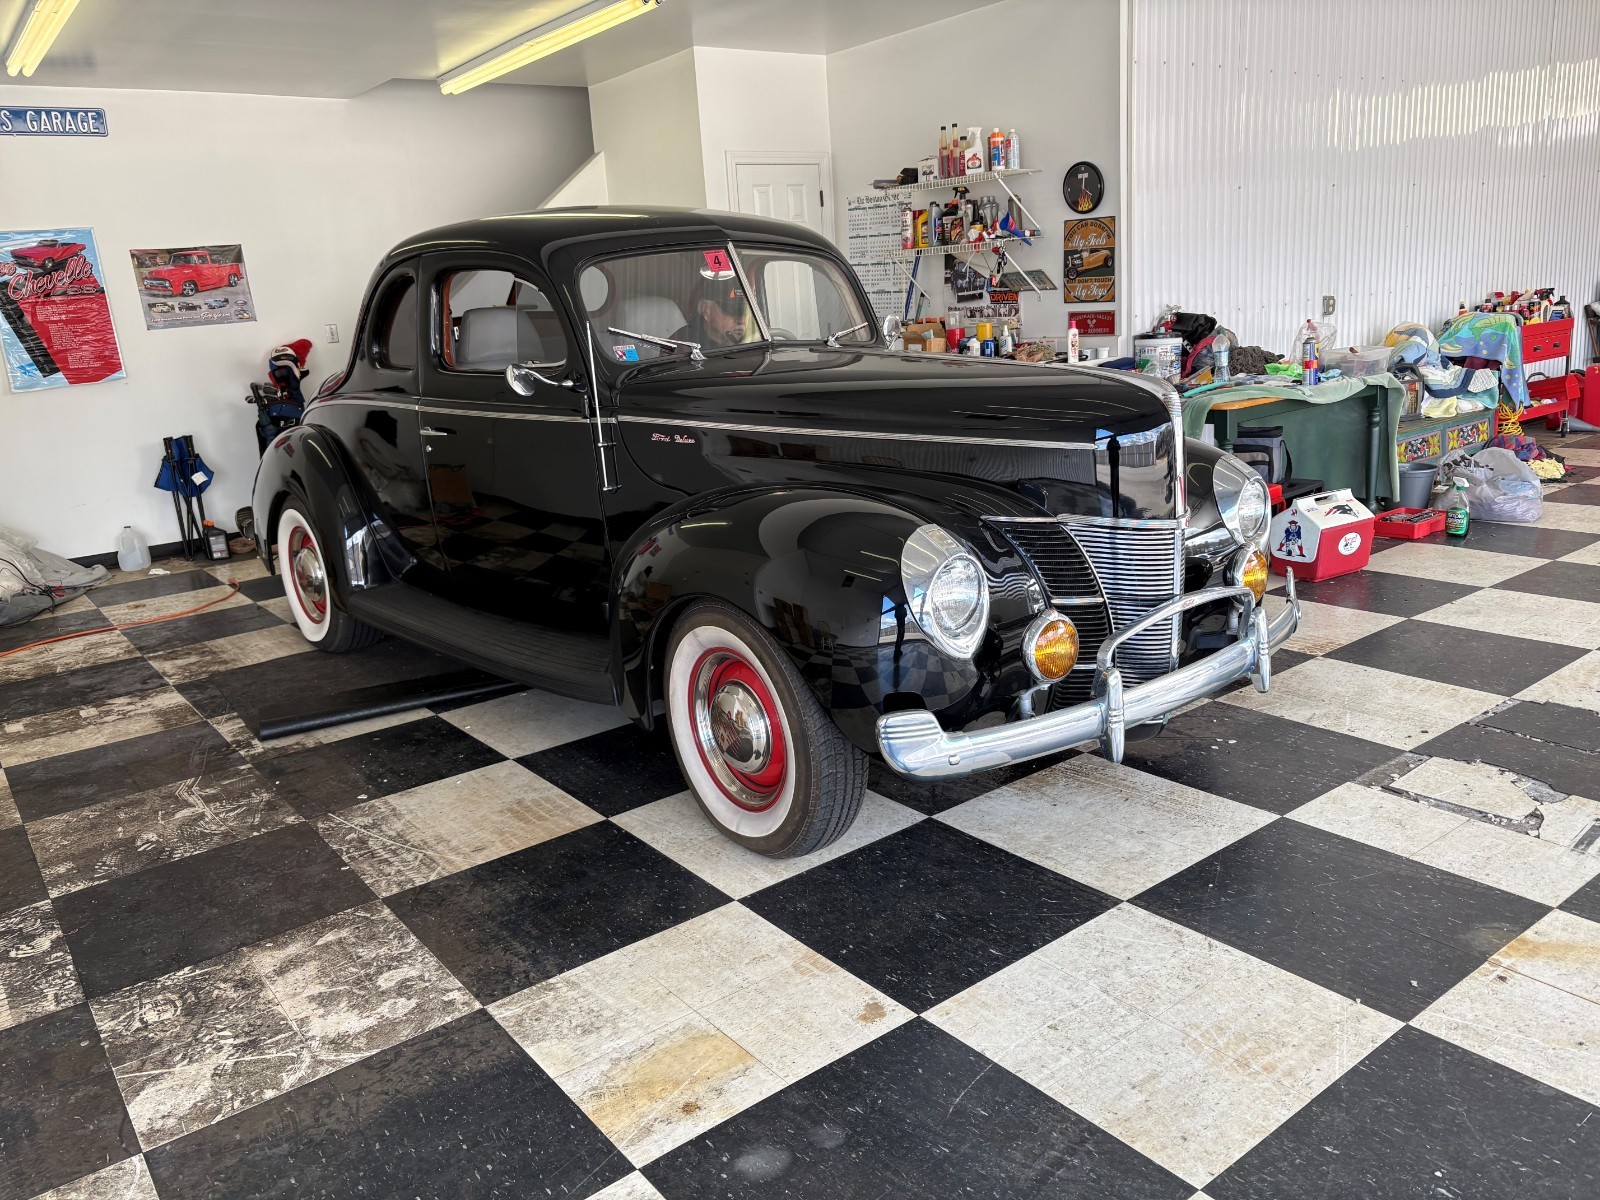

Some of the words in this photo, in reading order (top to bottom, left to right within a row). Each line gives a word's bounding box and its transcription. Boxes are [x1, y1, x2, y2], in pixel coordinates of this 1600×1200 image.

[0, 110, 13, 132] S
[26, 110, 99, 133] GARAGE
[1067, 229, 1077, 241] YOU
[1077, 222, 1089, 230] CAN
[1090, 221, 1112, 239] BORROW
[1068, 234, 1085, 250] My
[1085, 231, 1107, 246] Tools
[713, 255, 722, 266] 4
[7, 254, 93, 301] Chevelle
[990, 293, 1018, 302] DRIVEN
[1070, 284, 1087, 299] My
[1087, 283, 1108, 299] Toys
[651, 432, 671, 442] Ford
